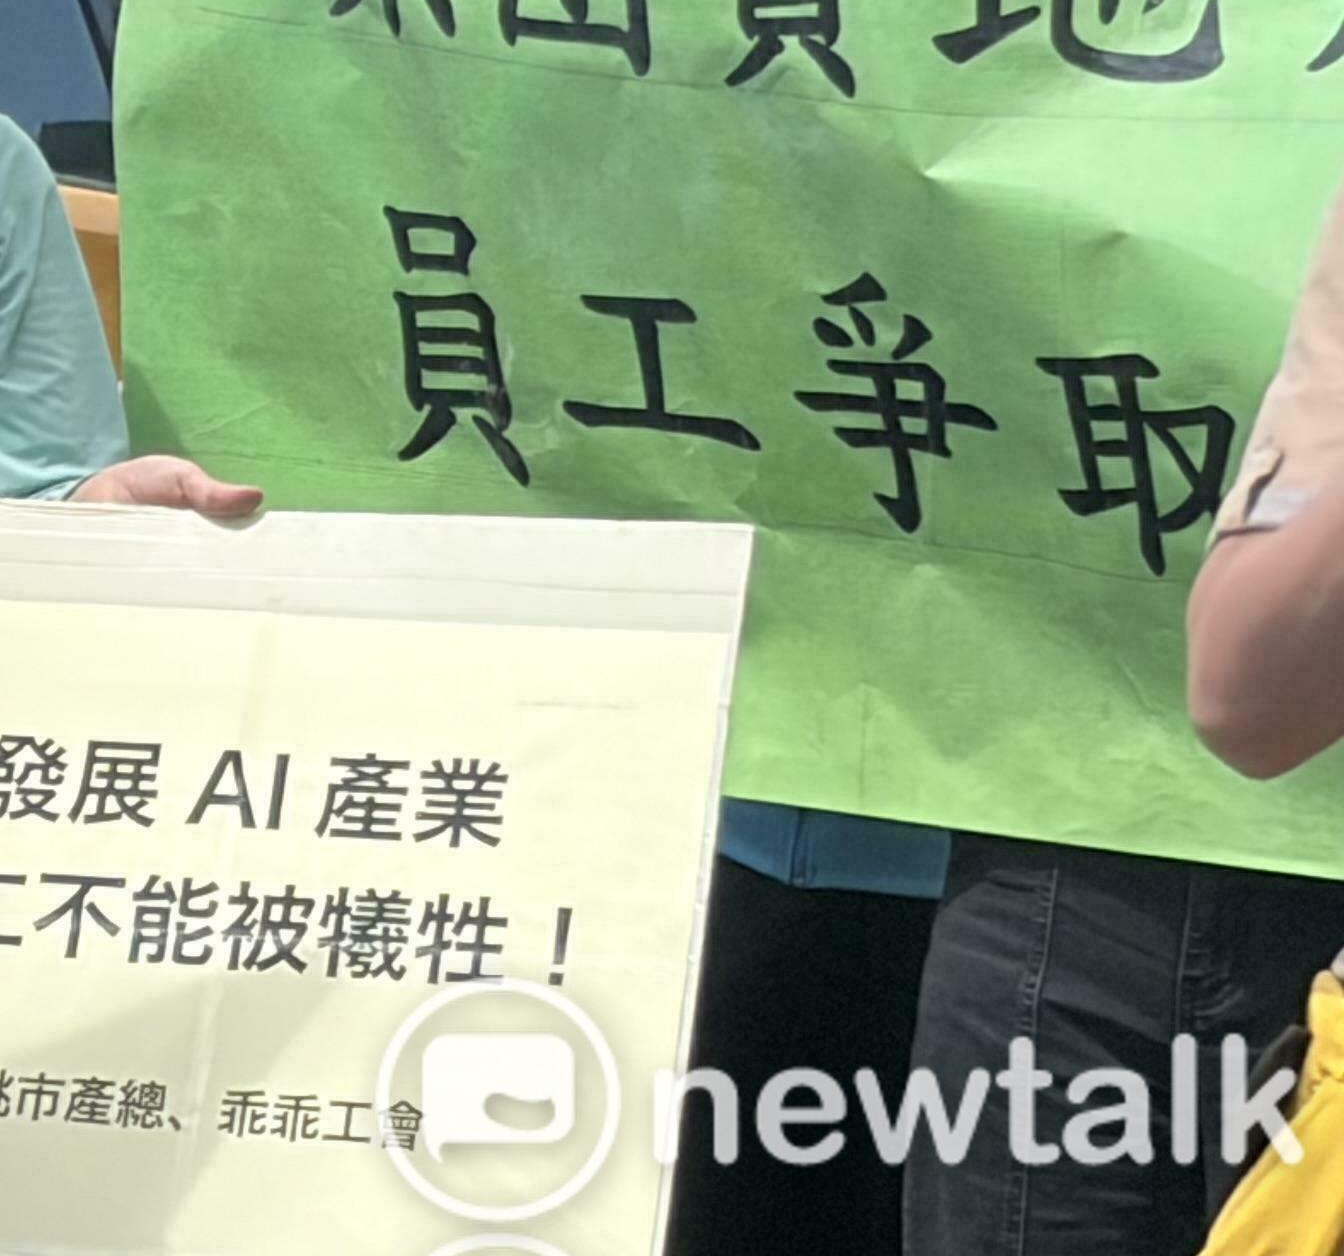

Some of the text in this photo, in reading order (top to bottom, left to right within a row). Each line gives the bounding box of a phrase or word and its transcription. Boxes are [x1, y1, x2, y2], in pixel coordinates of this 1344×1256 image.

[382, 204, 1239, 579] 員工爭取
[187, 746, 289, 833] AI
[312, 751, 509, 850] 產業
